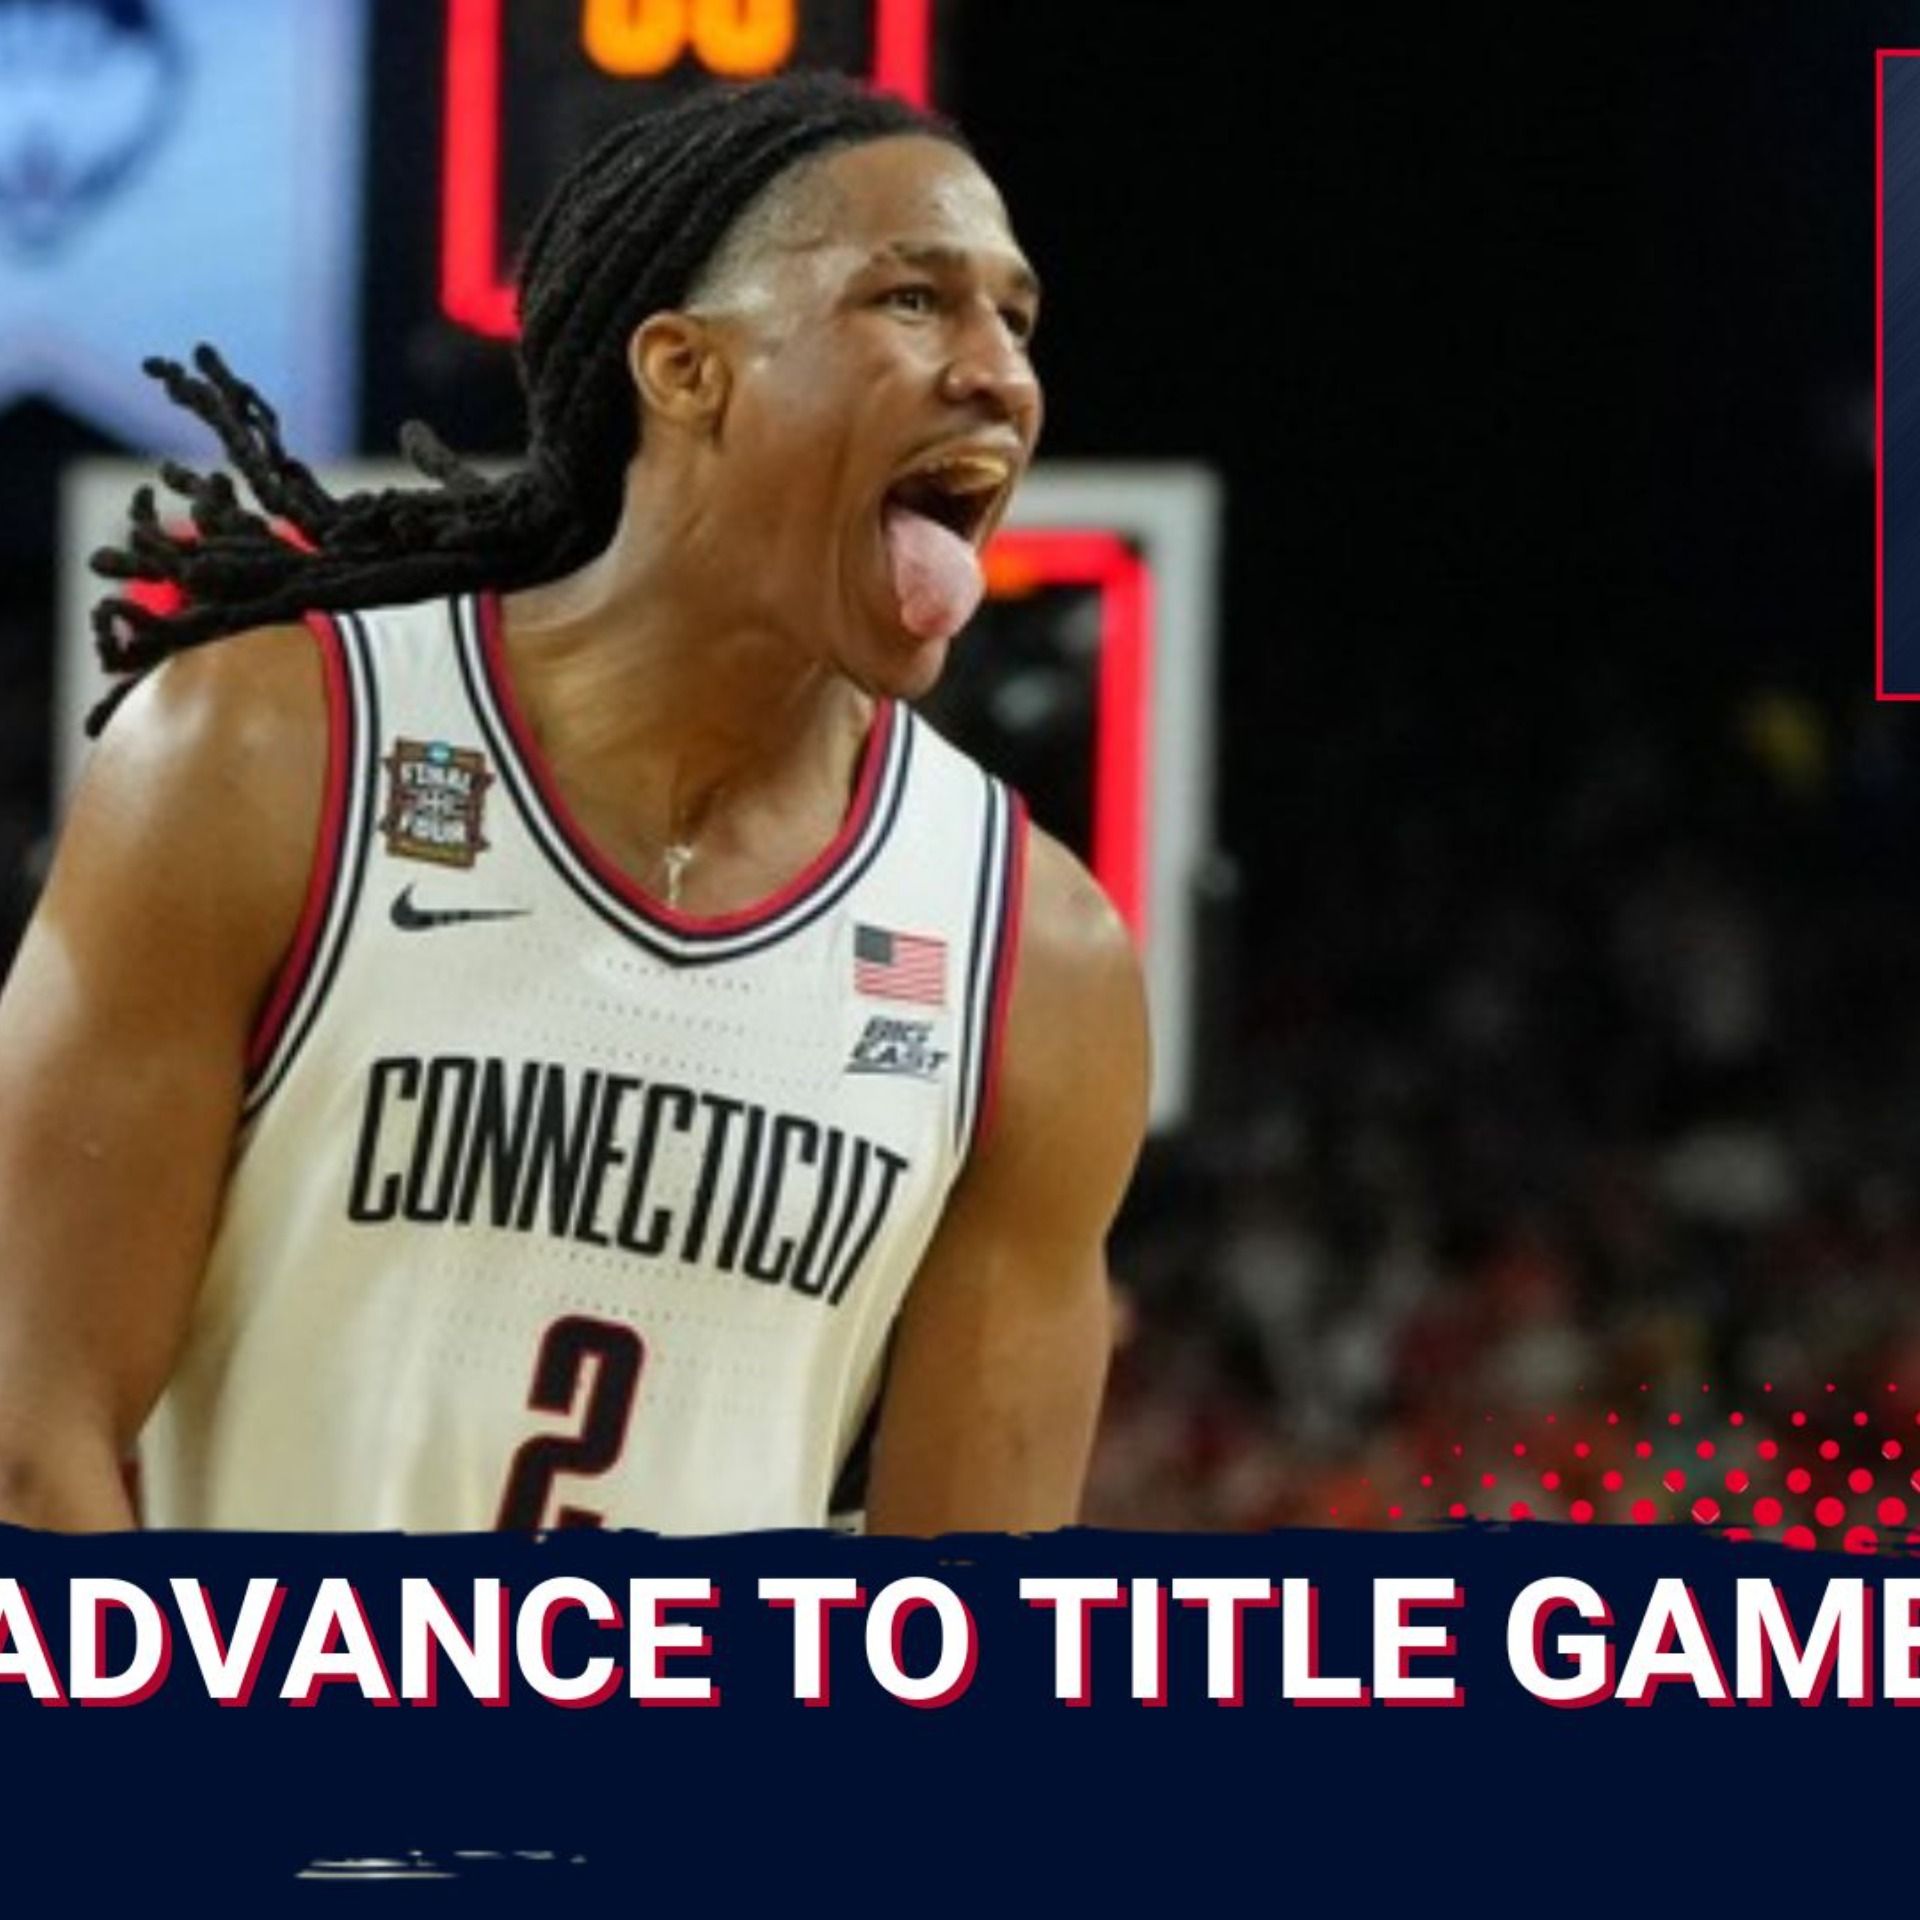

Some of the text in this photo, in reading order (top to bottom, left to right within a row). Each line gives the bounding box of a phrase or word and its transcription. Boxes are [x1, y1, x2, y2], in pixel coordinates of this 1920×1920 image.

[399, 808, 468, 844] FOUR
[846, 1039, 949, 1080] EAST
[347, 1056, 910, 1307] CONNECTICUT
[496, 1314, 646, 1532] 2
